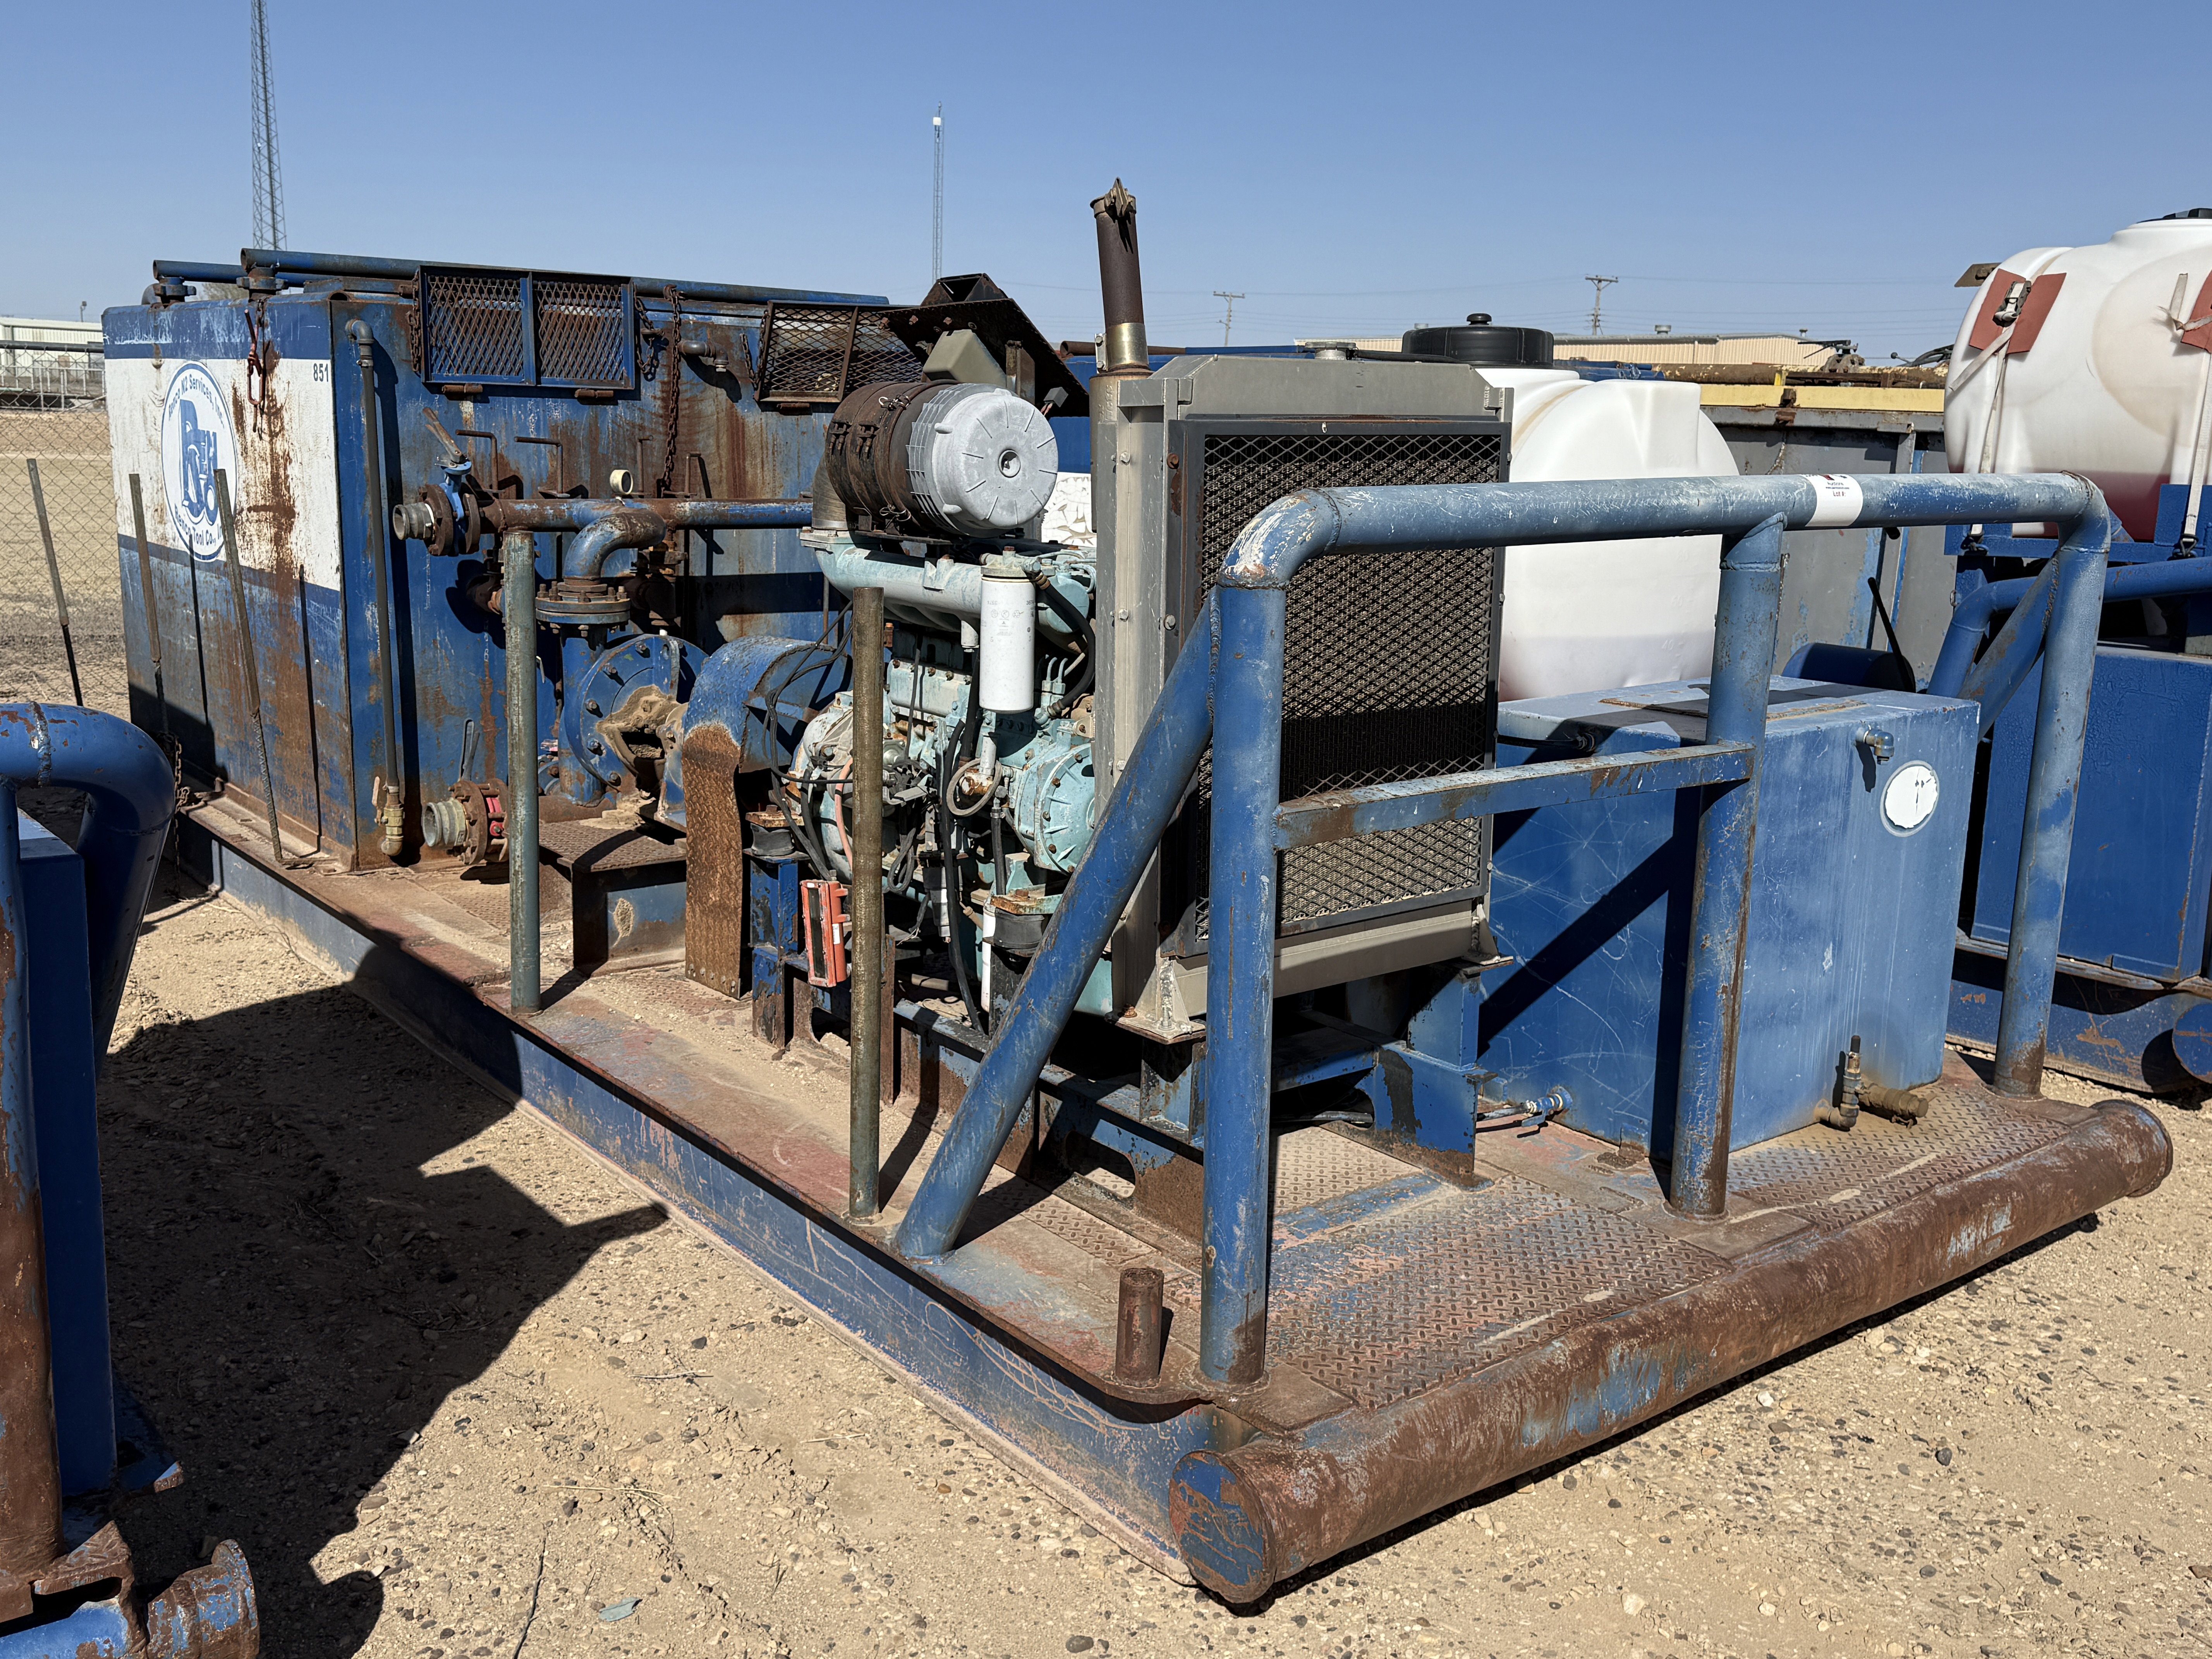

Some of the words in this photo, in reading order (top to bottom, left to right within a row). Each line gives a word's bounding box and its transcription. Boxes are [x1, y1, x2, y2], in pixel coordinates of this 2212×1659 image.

[313, 363, 328, 382] 851
[181, 376, 188, 395] N2
[189, 374, 214, 410] Services,
[192, 526, 204, 546] Tool
